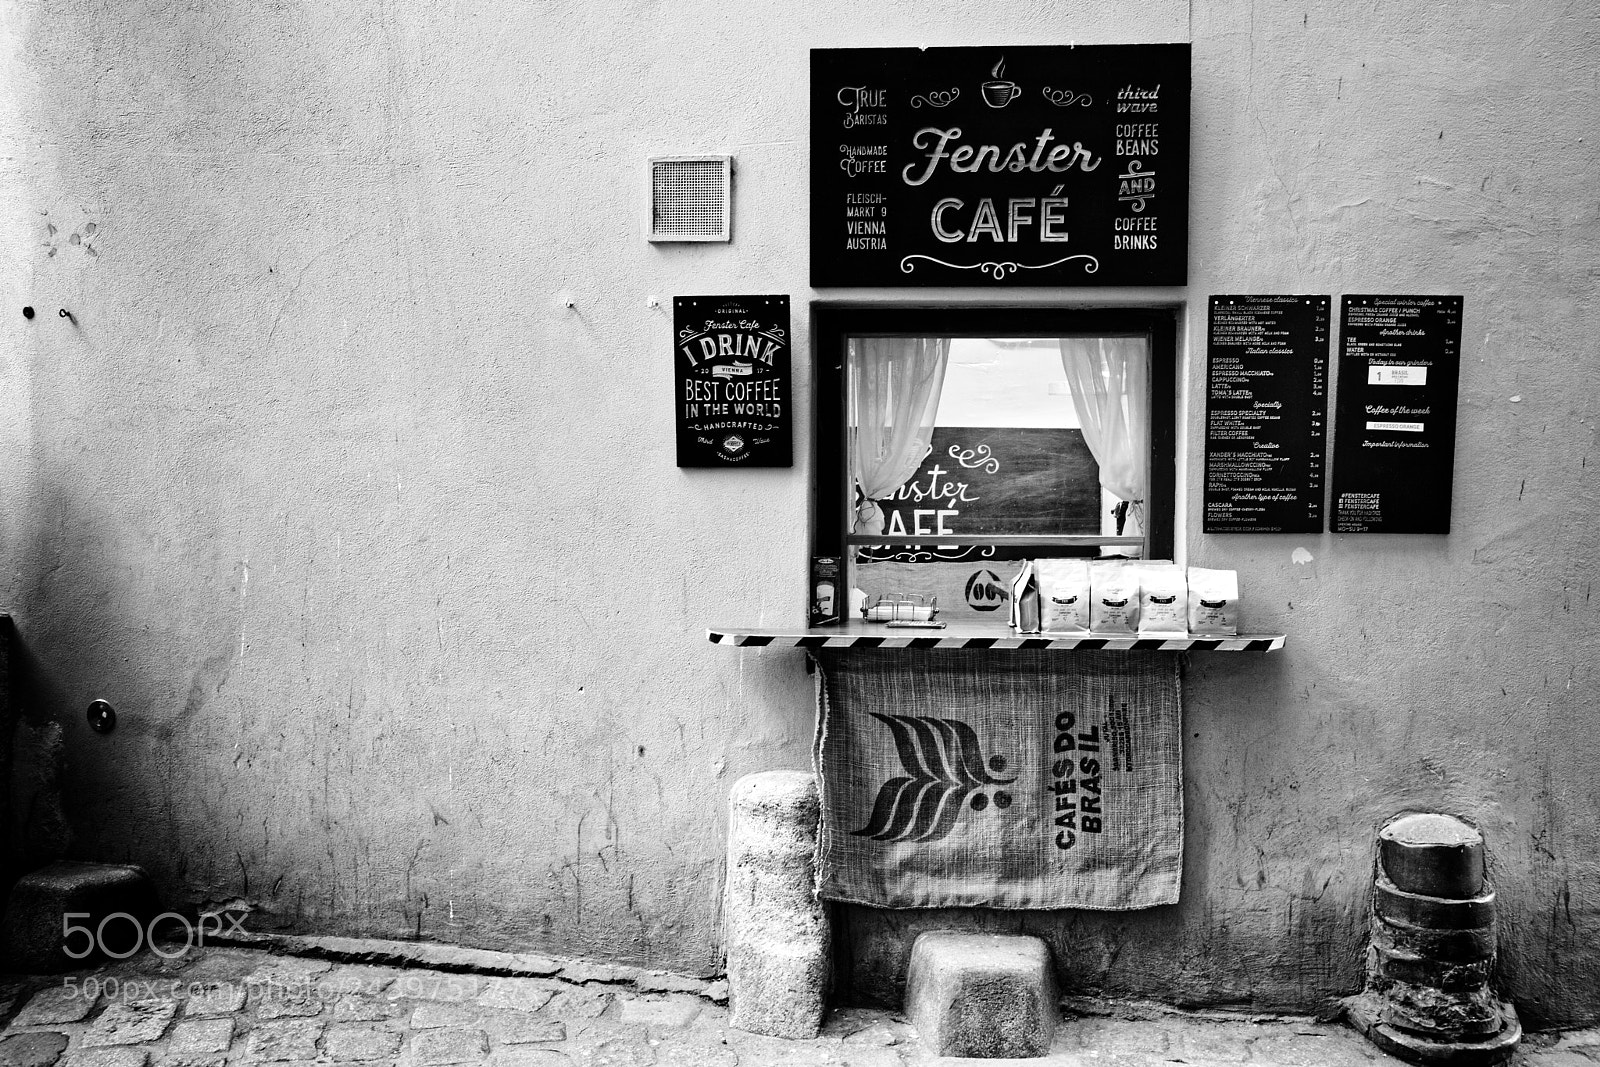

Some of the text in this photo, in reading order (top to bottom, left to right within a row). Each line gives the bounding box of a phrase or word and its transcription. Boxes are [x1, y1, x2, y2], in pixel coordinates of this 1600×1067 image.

[1117, 84, 1161, 100] third
[837, 86, 887, 114] TRUE
[1117, 103, 1158, 113] wave
[843, 112, 888, 129] BARISTAS
[1116, 124, 1159, 137] COFFEE
[839, 144, 888, 158] HANDMADE
[1116, 139, 1159, 156] BEANS
[902, 127, 1101, 187] Fenster
[840, 158, 887, 177] COFFEE
[1118, 177, 1156, 195] AND
[846, 193, 887, 204] FLEISCH-
[846, 206, 887, 217] MARKT 9
[931, 184, 1069, 243] CAFÉ
[847, 221, 886, 235] VIENNA
[1114, 217, 1157, 231] COFFEE
[846, 237, 887, 250] AUSTRIA
[1114, 235, 1157, 250] DRINKS
[703, 320, 738, 332] Fenster
[682, 334, 781, 367] I DRINK
[1368, 358, 1388, 367] Today
[1377, 371, 1381, 381] 1
[686, 378, 781, 401] BEST COFFEE
[685, 403, 781, 419] IN THE WORLD
[1365, 405, 1430, 416] Coffee of the week
[703, 421, 763, 431] HANDCRAFTED
[1362, 440, 1429, 449] Important information
[1257, 493, 1271, 502] type
[1272, 493, 1279, 501] of
[1279, 493, 1298, 502] coffee
[871, 498, 959, 550] AFÉ
[1048, 711, 1076, 850] CAFÉS DO
[1078, 725, 1101, 834] BRASIL
